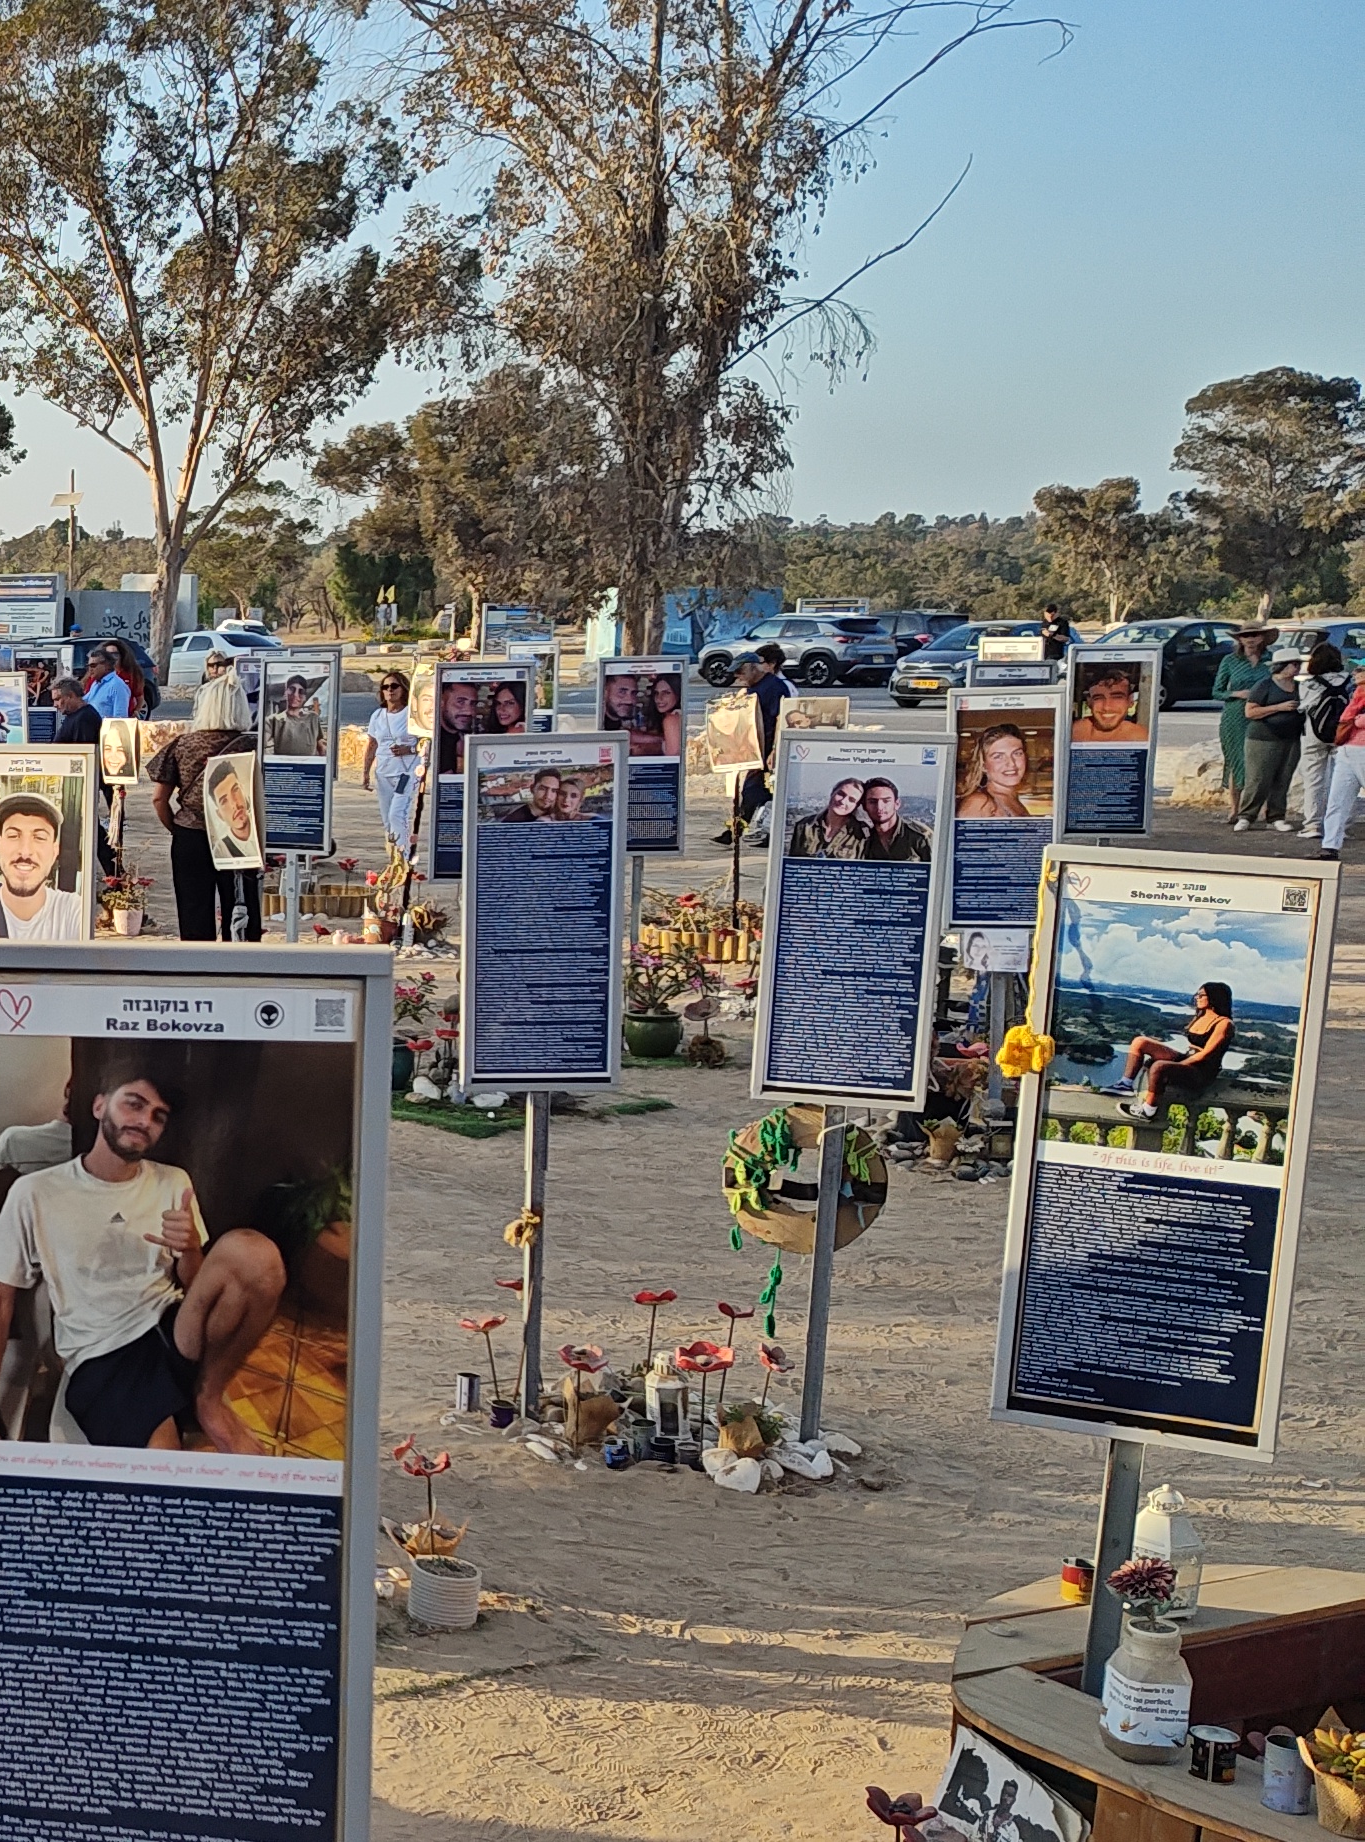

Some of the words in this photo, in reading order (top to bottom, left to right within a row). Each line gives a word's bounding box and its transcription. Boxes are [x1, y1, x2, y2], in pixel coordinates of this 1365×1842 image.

[1188, 893, 1232, 905] Yaakov
[122, 998, 190, 1015] בוקובזה
[194, 999, 214, 1014] רז
[105, 1017, 140, 1032] Raz
[146, 1018, 225, 1033] Bokovza
[1115, 1152, 1137, 1166] this
[1141, 1155, 1151, 1168] is
[1179, 1160, 1201, 1174] live
[10, 1455, 25, 1464] are
[27, 1453, 57, 1469] always
[87, 1457, 127, 1470] whatever
[129, 1462, 147, 1474] you
[174, 1463, 192, 1477] just
[237, 1469, 254, 1477] our
[257, 1467, 278, 1483] king
[280, 1469, 290, 1483] of
[291, 1469, 306, 1481] the
[1124, 1703, 1160, 1714] confident
[1133, 1695, 1143, 1704] be
[1143, 1697, 1173, 1707] perfect,
